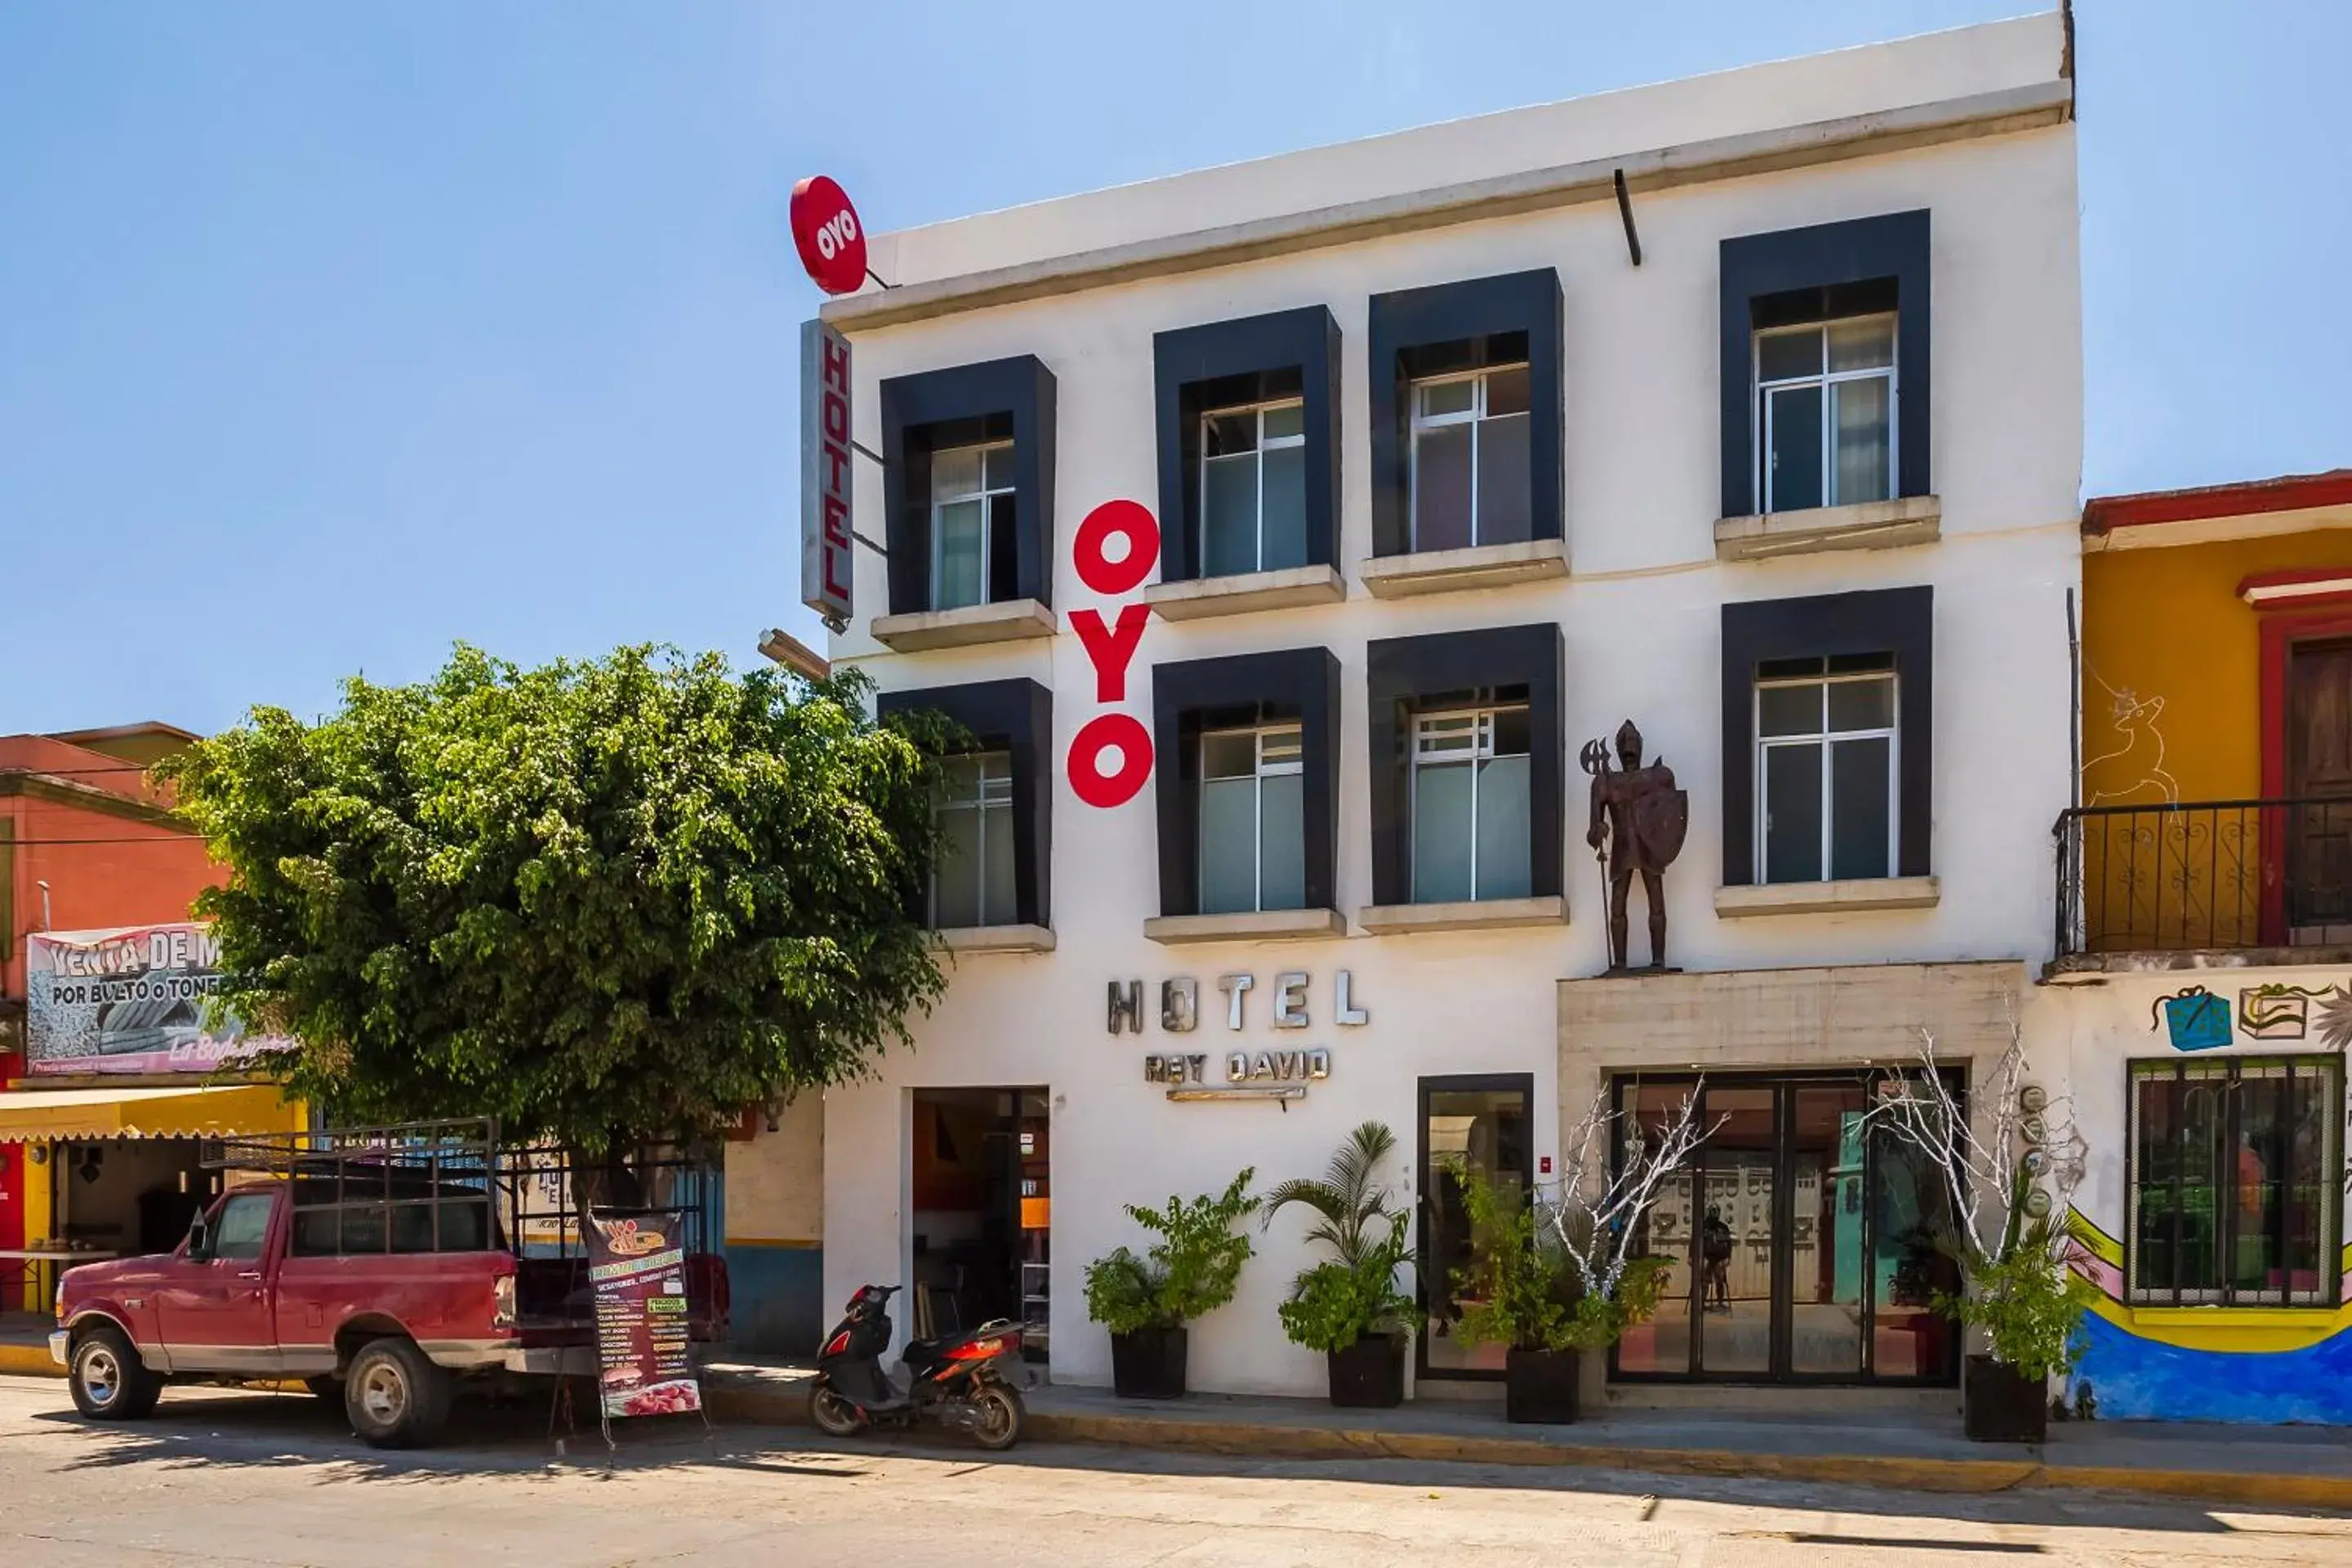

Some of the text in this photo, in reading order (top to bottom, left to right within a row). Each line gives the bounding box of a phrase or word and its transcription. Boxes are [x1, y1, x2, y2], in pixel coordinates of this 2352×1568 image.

[817, 209, 857, 260] OYO
[824, 335, 849, 602] HOTEL
[1067, 499, 1160, 808] OYO
[50, 938, 139, 976] VENTA
[149, 931, 187, 969] DE
[53, 984, 87, 1005] POR
[91, 982, 149, 1002] BULTO
[168, 978, 224, 999] TONE
[1107, 969, 1369, 1036] HOTEL
[1145, 1048, 1332, 1084] REY DAVID
